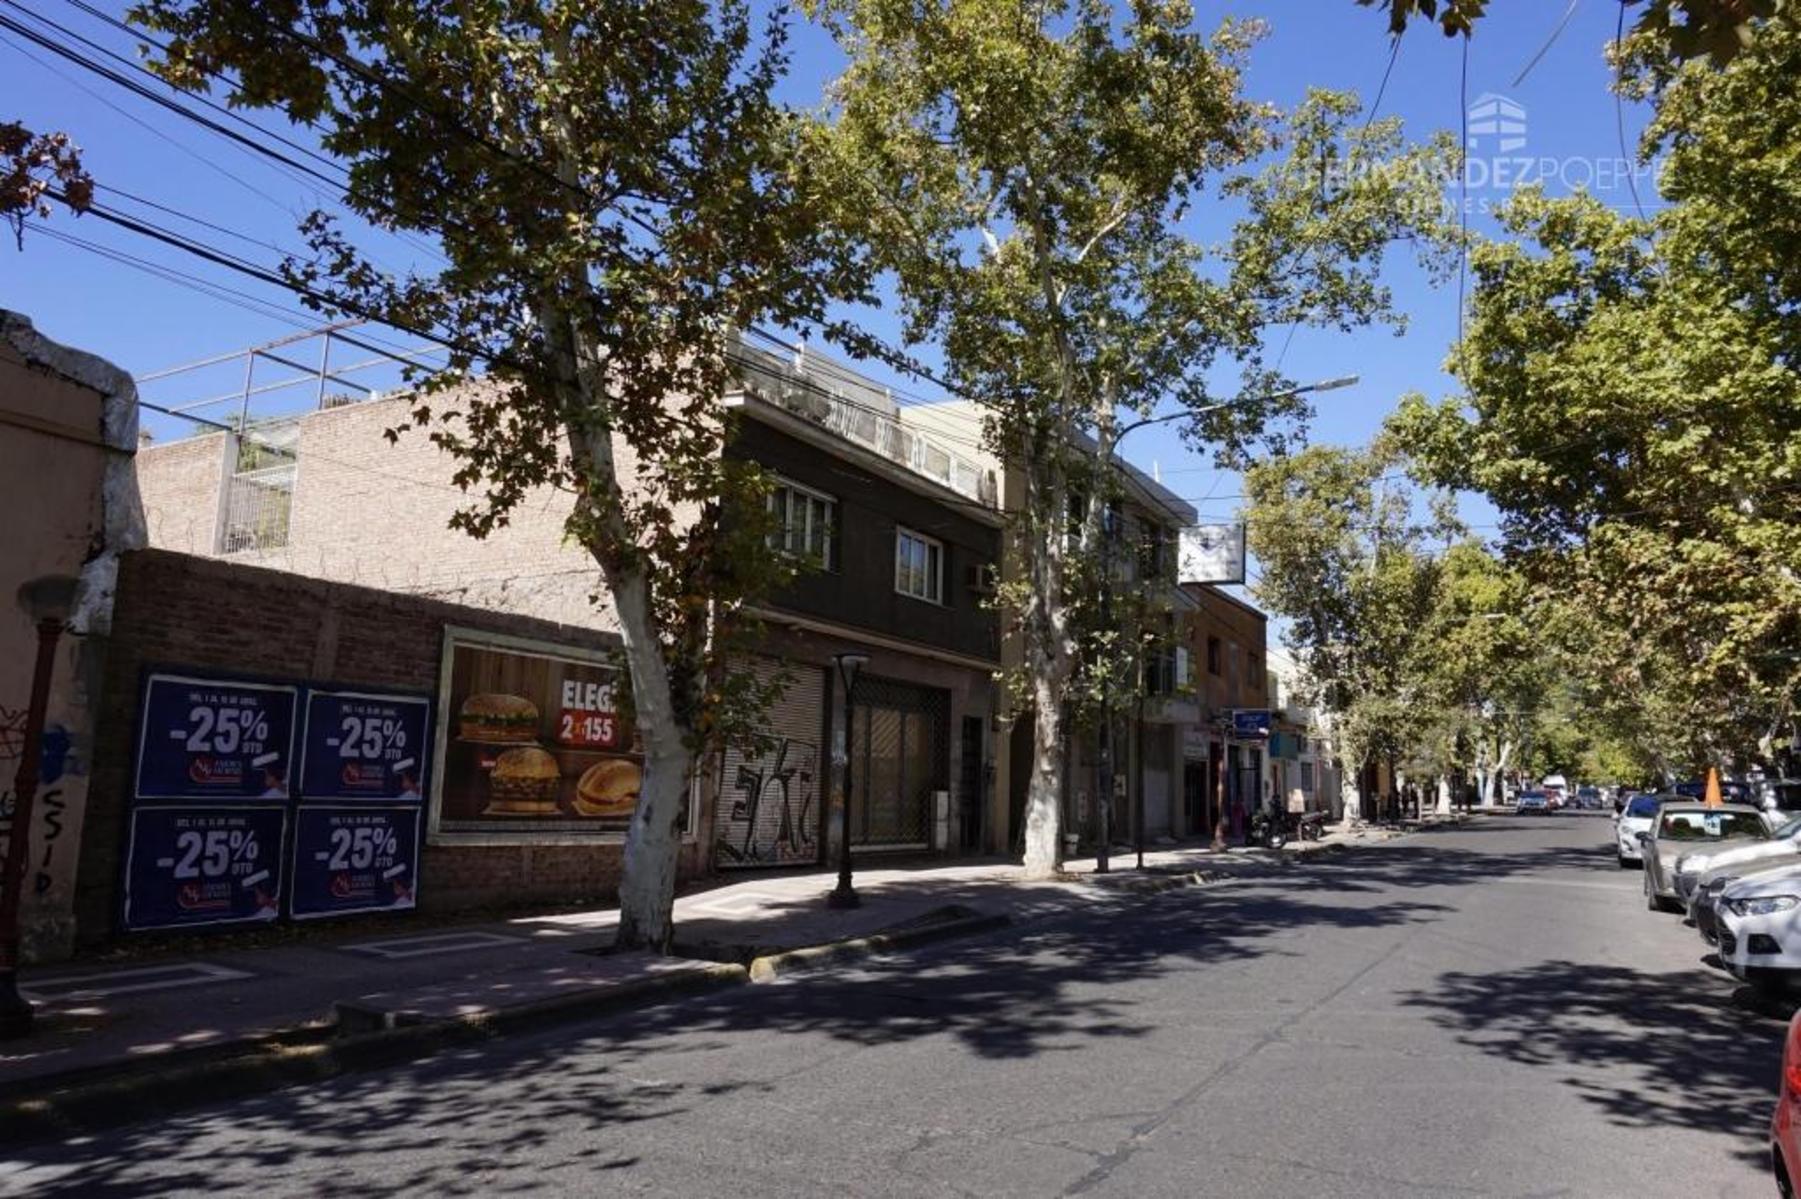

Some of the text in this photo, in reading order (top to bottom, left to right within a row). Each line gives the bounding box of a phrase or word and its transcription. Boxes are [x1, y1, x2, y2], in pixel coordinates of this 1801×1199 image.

[169, 705, 269, 755] -25%
[326, 716, 406, 759] -25%
[156, 829, 259, 879] -25%
[314, 827, 396, 872] -25%
